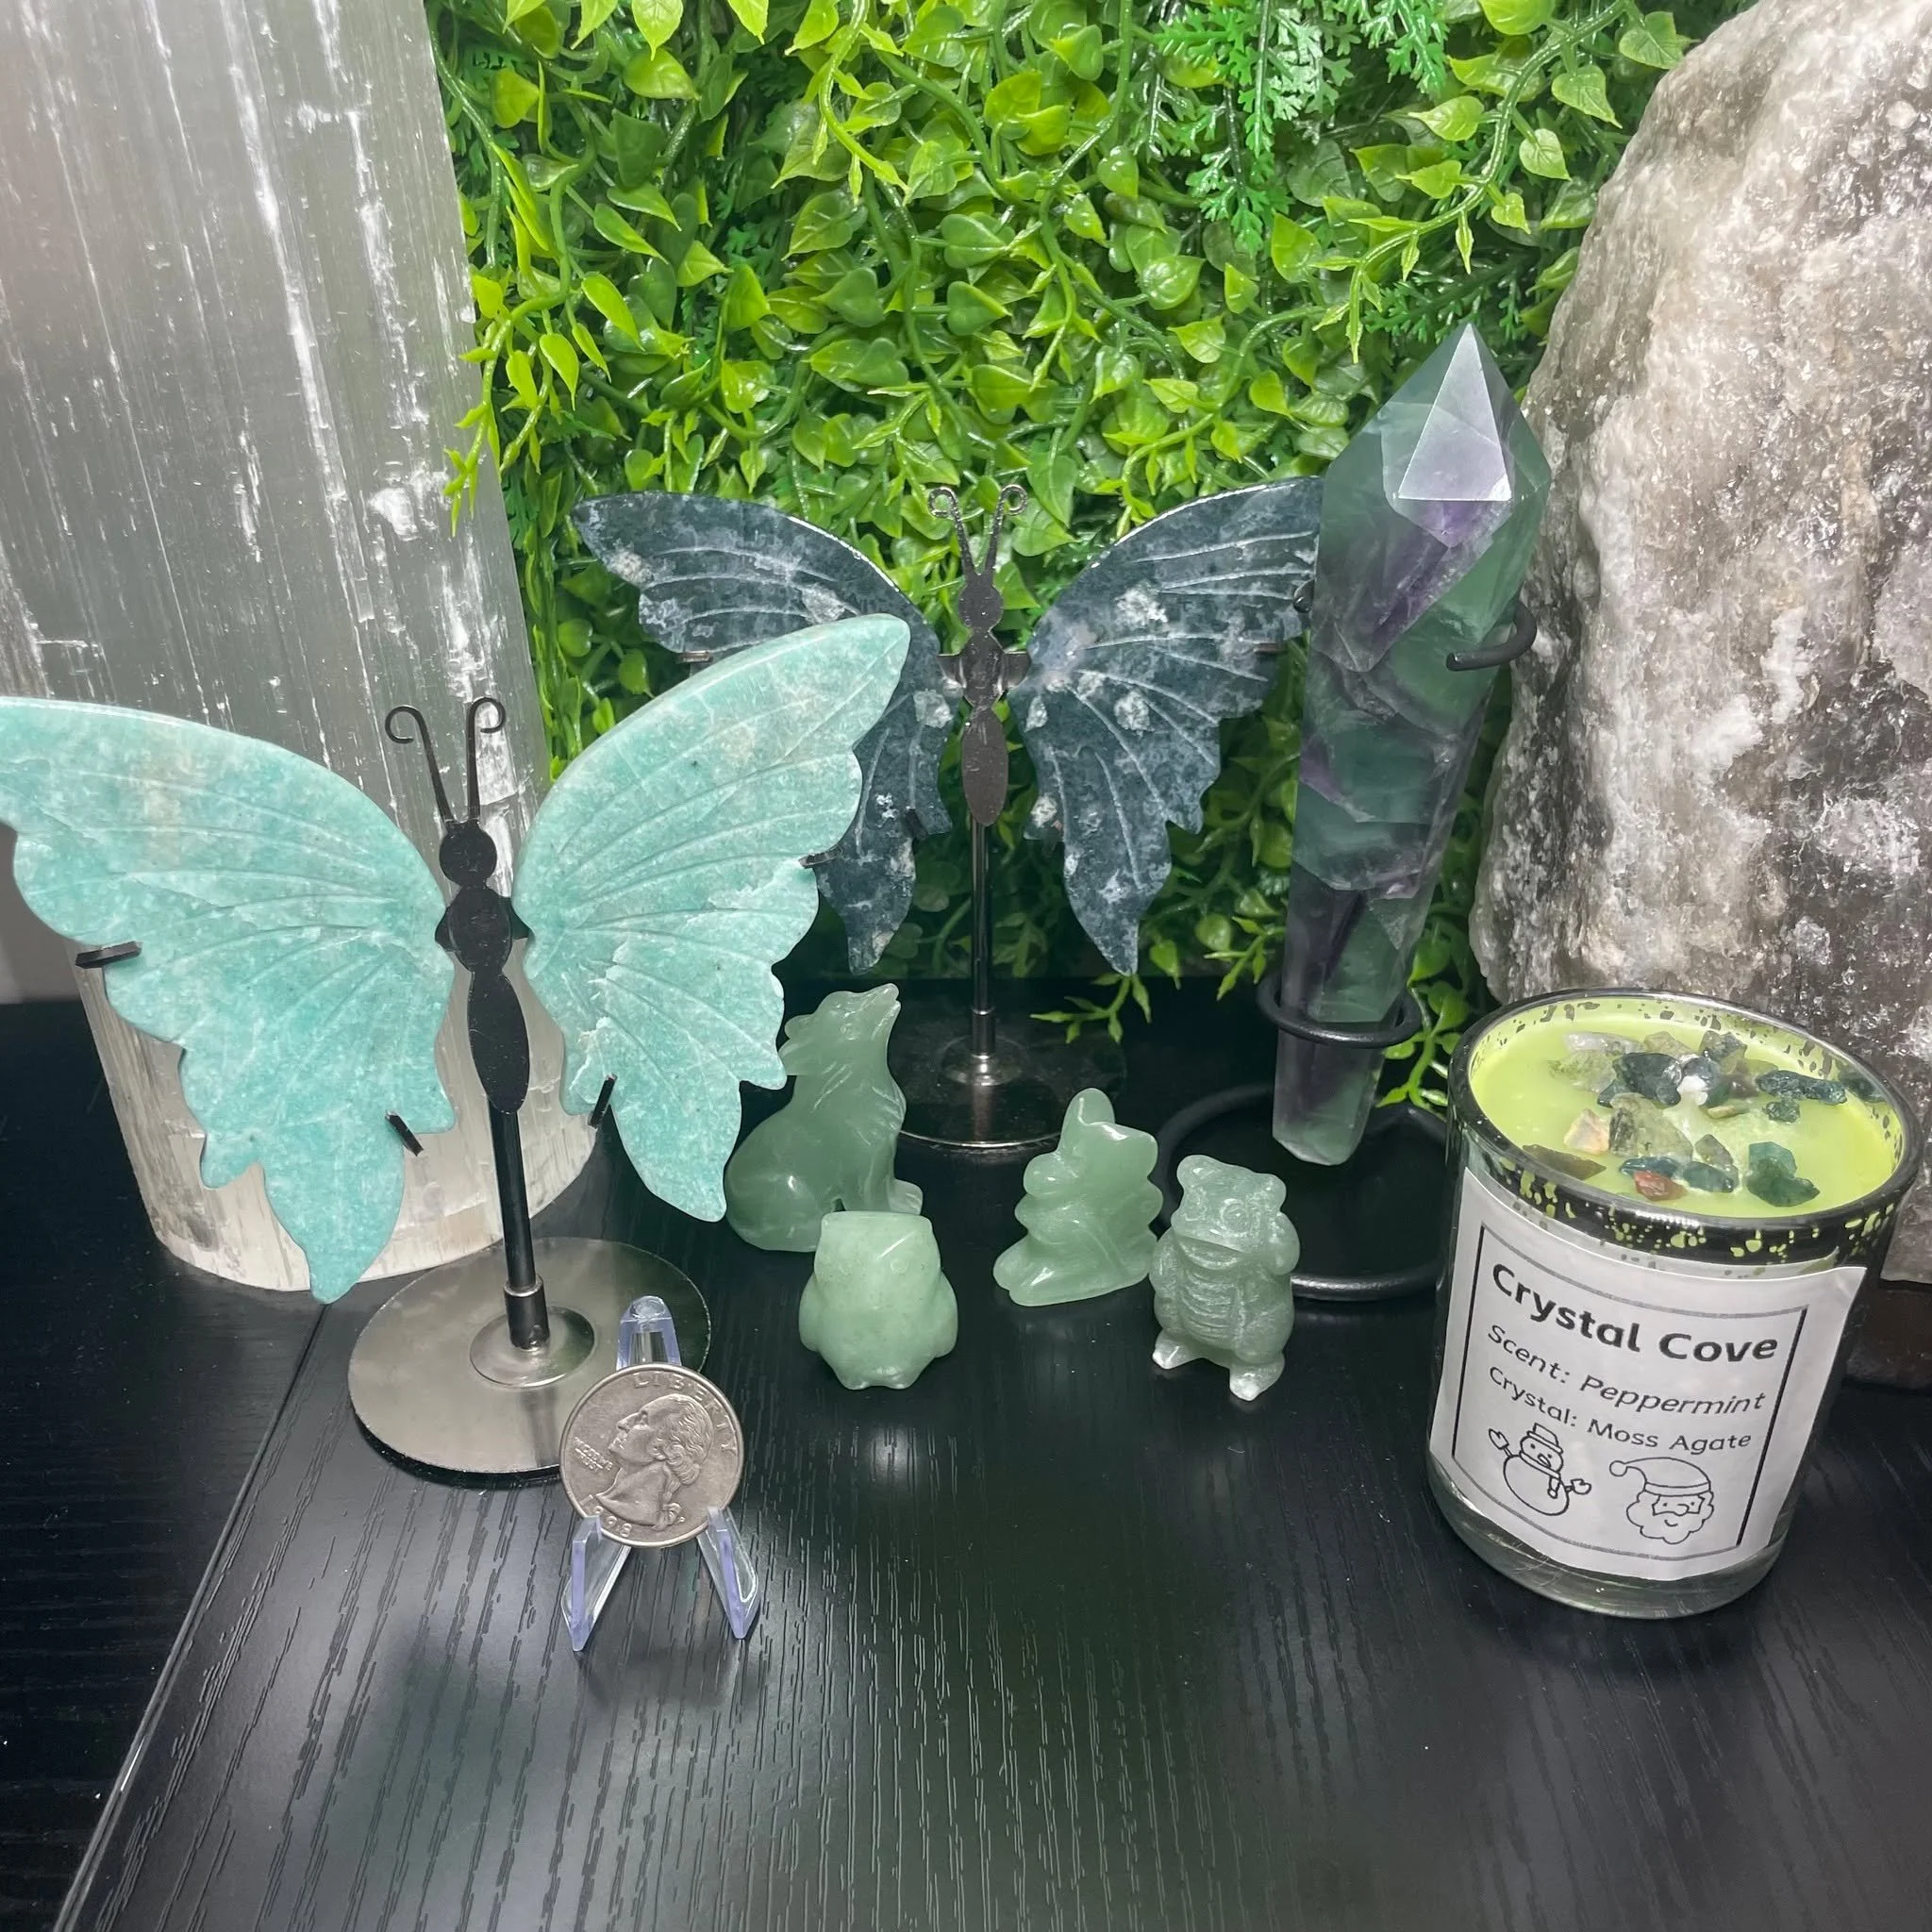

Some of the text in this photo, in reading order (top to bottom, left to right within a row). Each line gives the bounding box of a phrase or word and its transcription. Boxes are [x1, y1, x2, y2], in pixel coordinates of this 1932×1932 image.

[1491, 1262, 1778, 1362] Crystal Cove
[633, 1370, 738, 1457] LIBERTY
[1488, 1324, 1765, 1415] Scent: Peppermint
[1489, 1365, 1752, 1455] Crystal: Moss Agate
